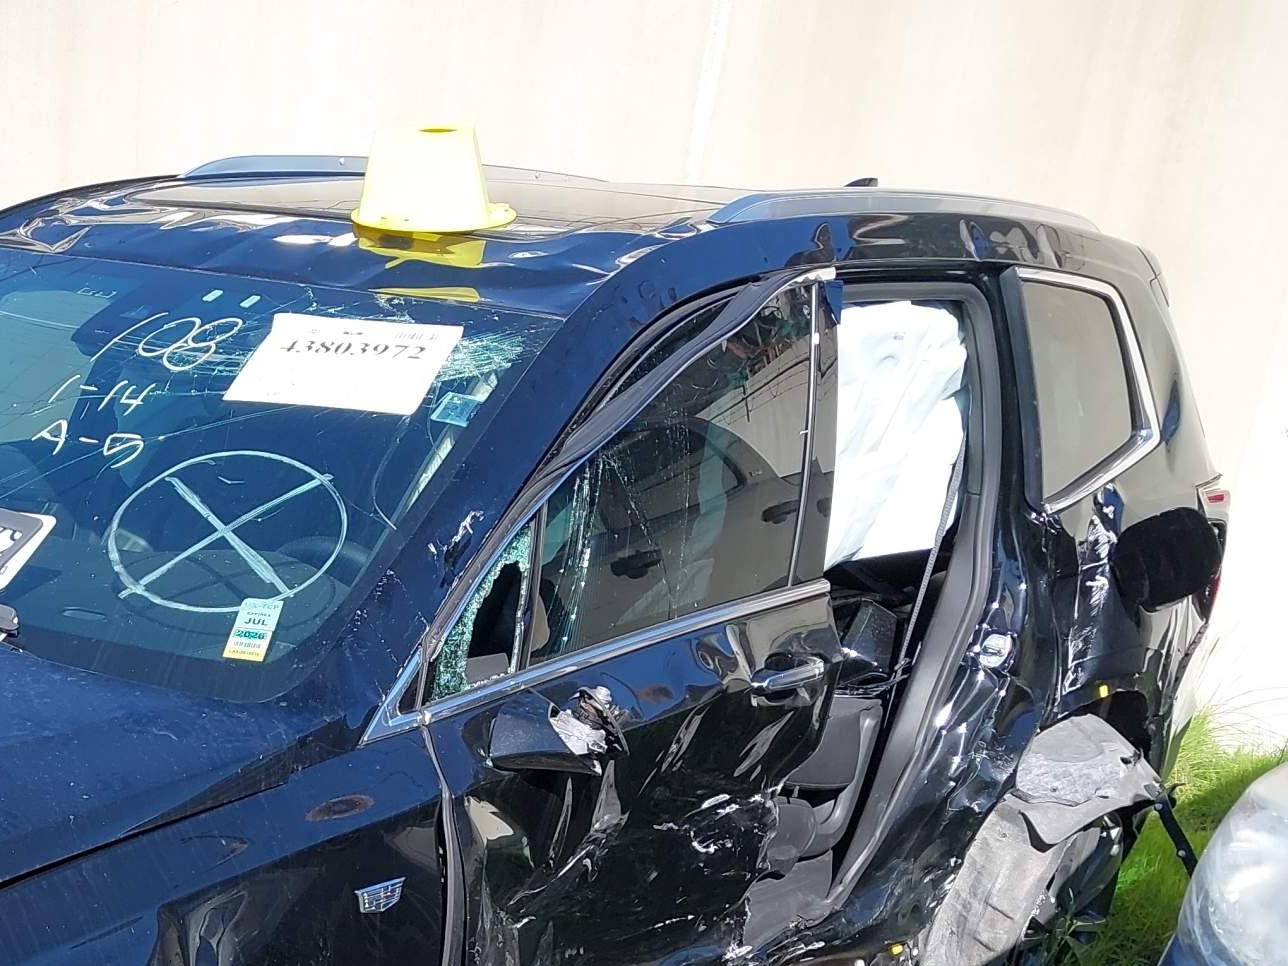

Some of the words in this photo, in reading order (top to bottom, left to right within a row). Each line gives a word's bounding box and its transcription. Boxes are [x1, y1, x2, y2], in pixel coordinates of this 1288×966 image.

[280, 340, 426, 359] 43803972
[244, 618, 268, 626] JUL
[235, 630, 265, 640] 2026
